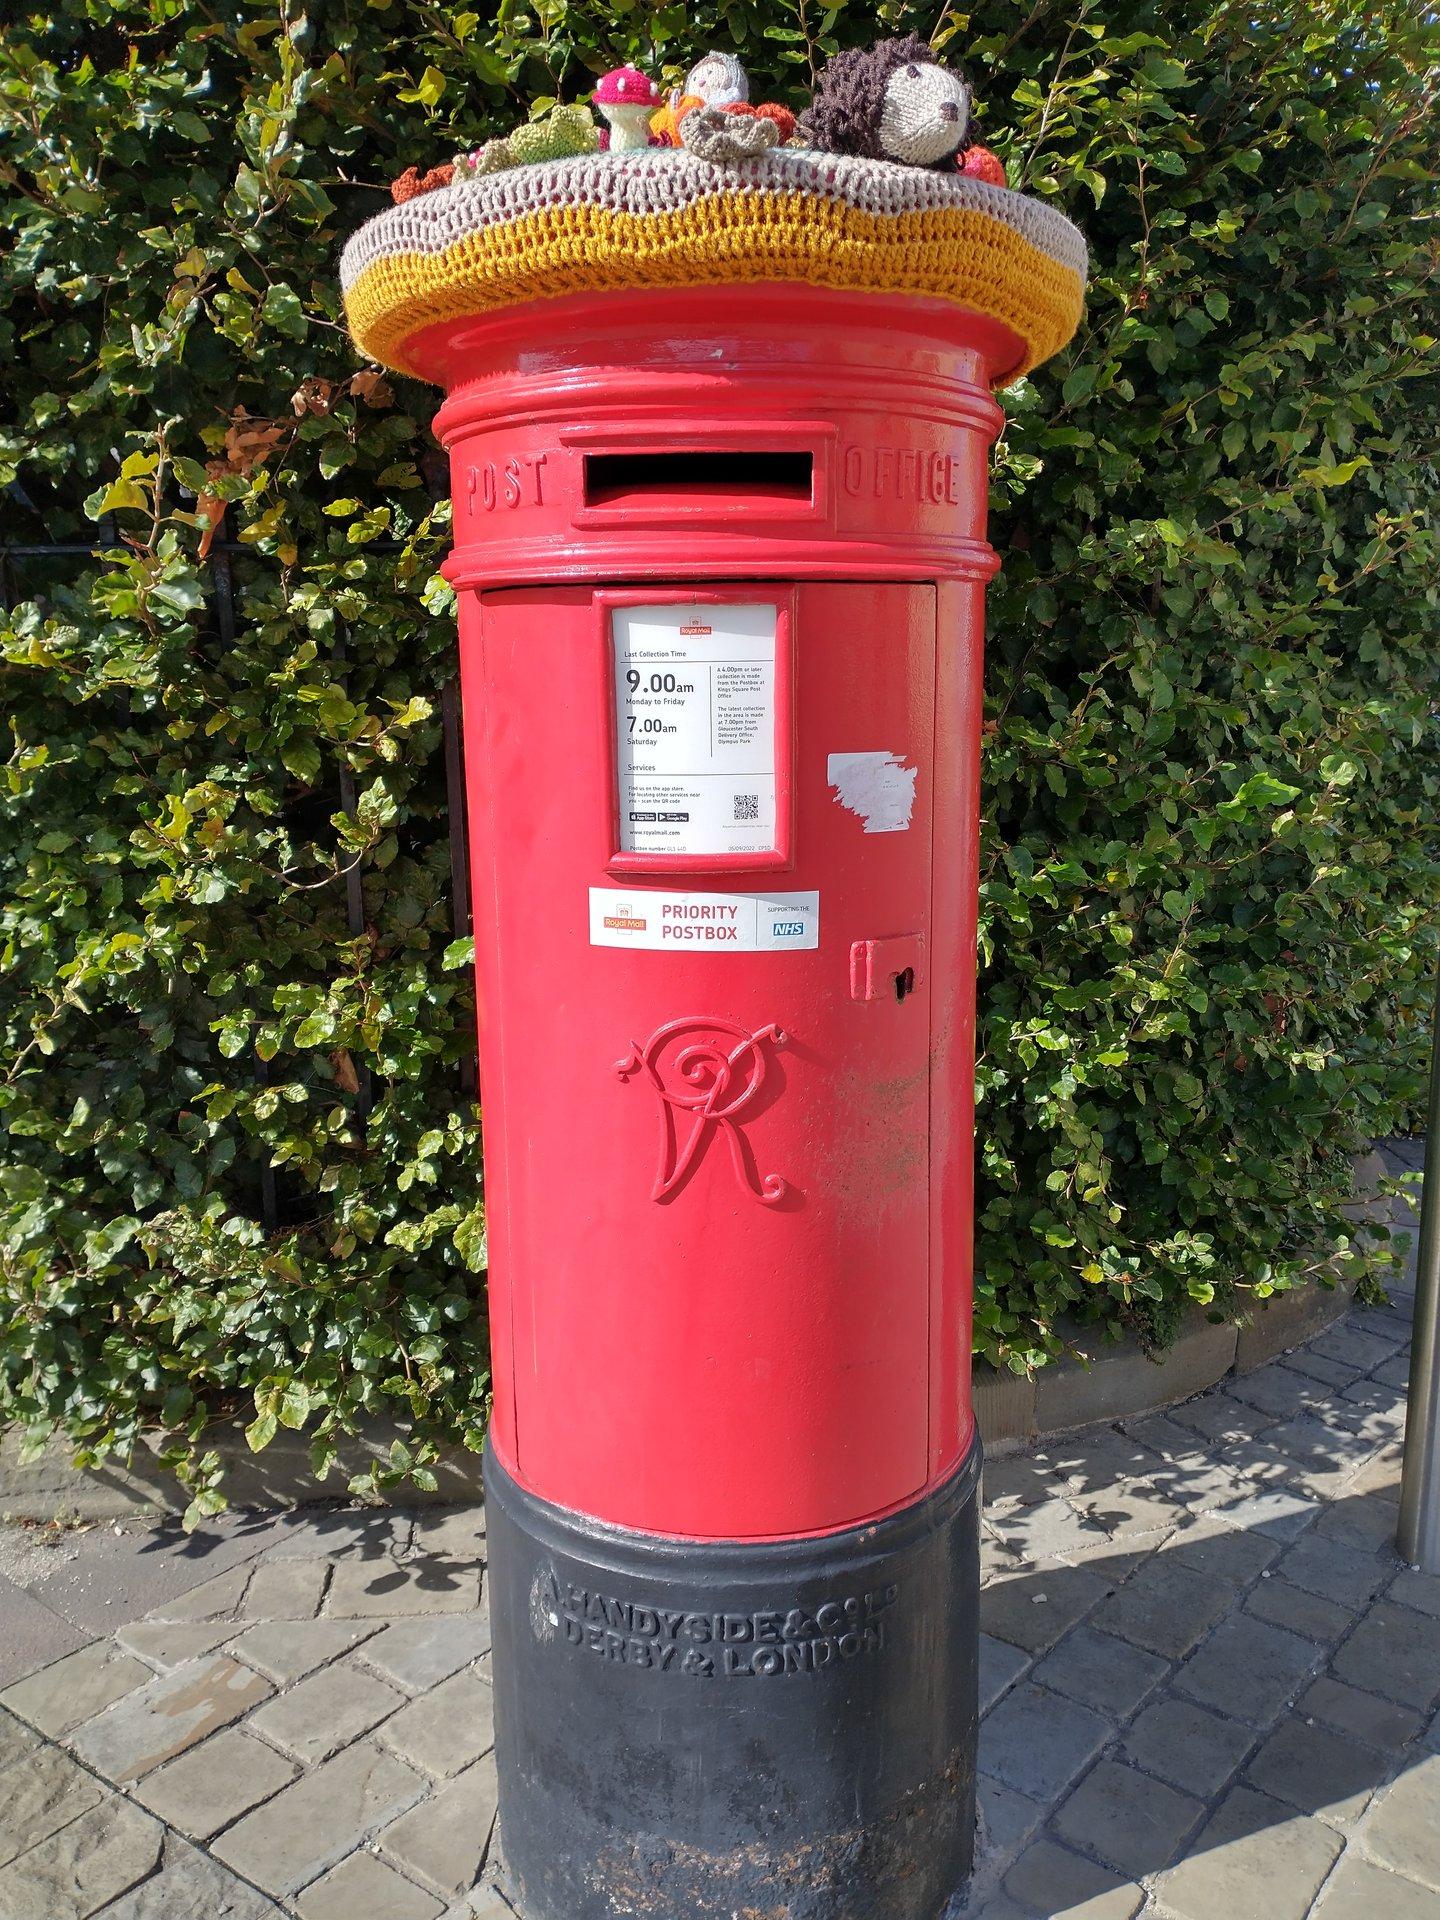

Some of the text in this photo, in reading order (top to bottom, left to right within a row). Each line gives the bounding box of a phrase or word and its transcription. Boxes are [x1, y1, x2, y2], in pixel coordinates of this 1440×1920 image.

[844, 444, 959, 507] OFFICE
[465, 452, 548, 516] POST
[681, 627, 698, 635] Royal
[626, 669, 694, 693] 9.00am
[627, 716, 677, 733] 7.00am
[627, 738, 657, 746] Saturday
[661, 904, 739, 919] PRIORITY
[604, 918, 645, 929] Royal Mail
[775, 923, 802, 935] NHS
[661, 925, 738, 940] POSTBOX
[563, 1612, 885, 1678] DERBY & LONDON
